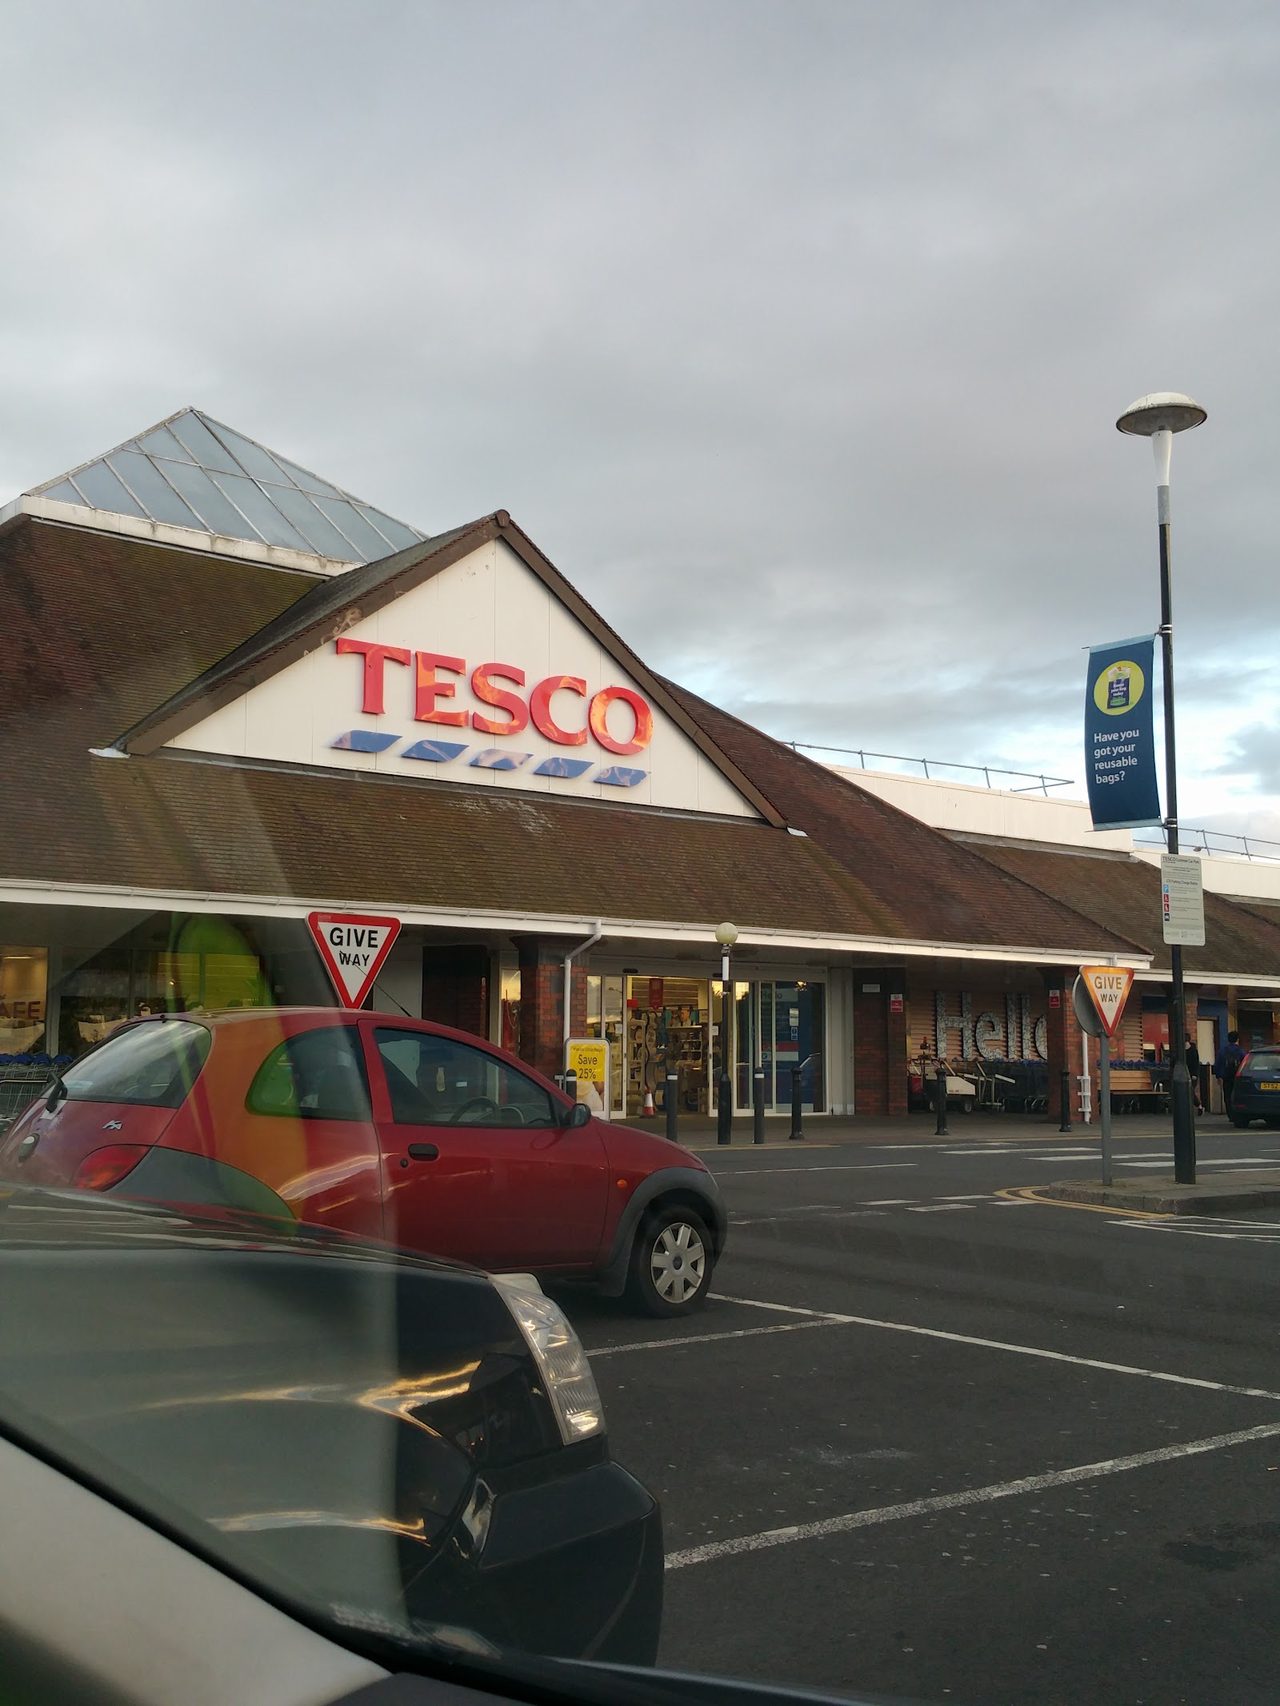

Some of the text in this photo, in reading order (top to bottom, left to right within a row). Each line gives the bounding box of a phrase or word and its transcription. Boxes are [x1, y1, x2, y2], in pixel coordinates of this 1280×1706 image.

[336, 637, 655, 755] TESCO
[1094, 729, 1139, 743] Have you
[1094, 742, 1136, 758] got your
[1095, 756, 1138, 770] reusable
[1096, 771, 1126, 785] bags?
[330, 927, 378, 948] GIVE
[339, 952, 370, 967] WAY
[1094, 976, 1122, 990] GIVE
[1100, 993, 1118, 1002] WAY
[578, 1054, 597, 1065] Save
[578, 1068, 596, 1079] 25%
